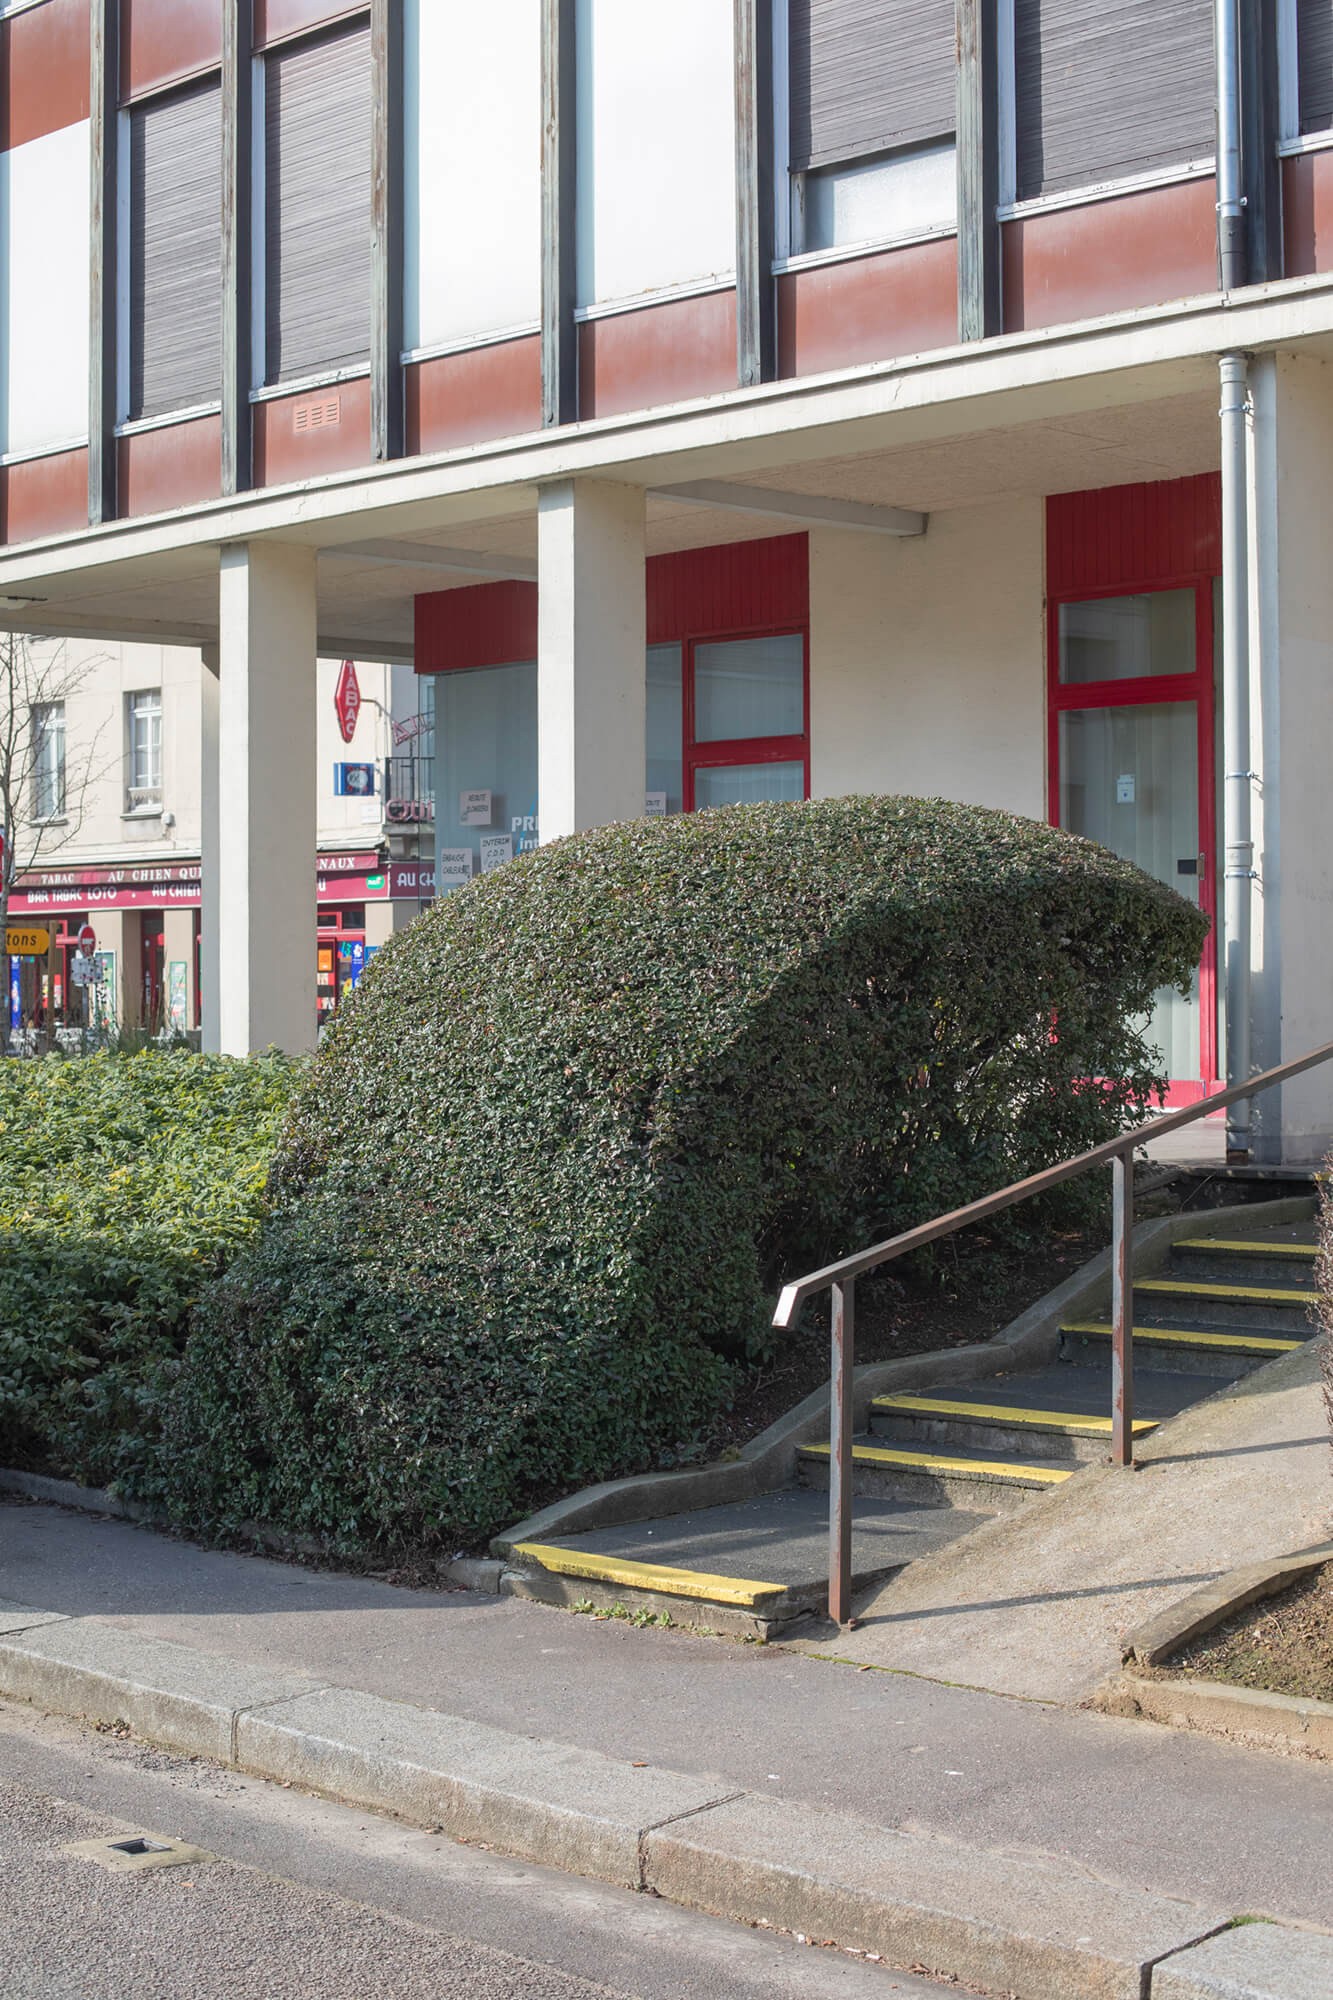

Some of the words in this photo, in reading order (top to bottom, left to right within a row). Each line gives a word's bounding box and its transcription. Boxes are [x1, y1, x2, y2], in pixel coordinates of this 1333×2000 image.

[345, 662, 357, 735] TABAC
[41, 873, 75, 885] TABAC
[108, 871, 124, 882] AU
[132, 868, 171, 881] CHIEN
[319, 857, 355, 870] NAUX
[397, 872, 416, 887] AU
[27, 889, 49, 904] BAR
[52, 887, 82, 902] TABAC
[87, 886, 117, 901] LOTO
[152, 883, 167, 897] AU
[168, 883, 200, 897] CHIEN
[7, 933, 37, 946] tons
